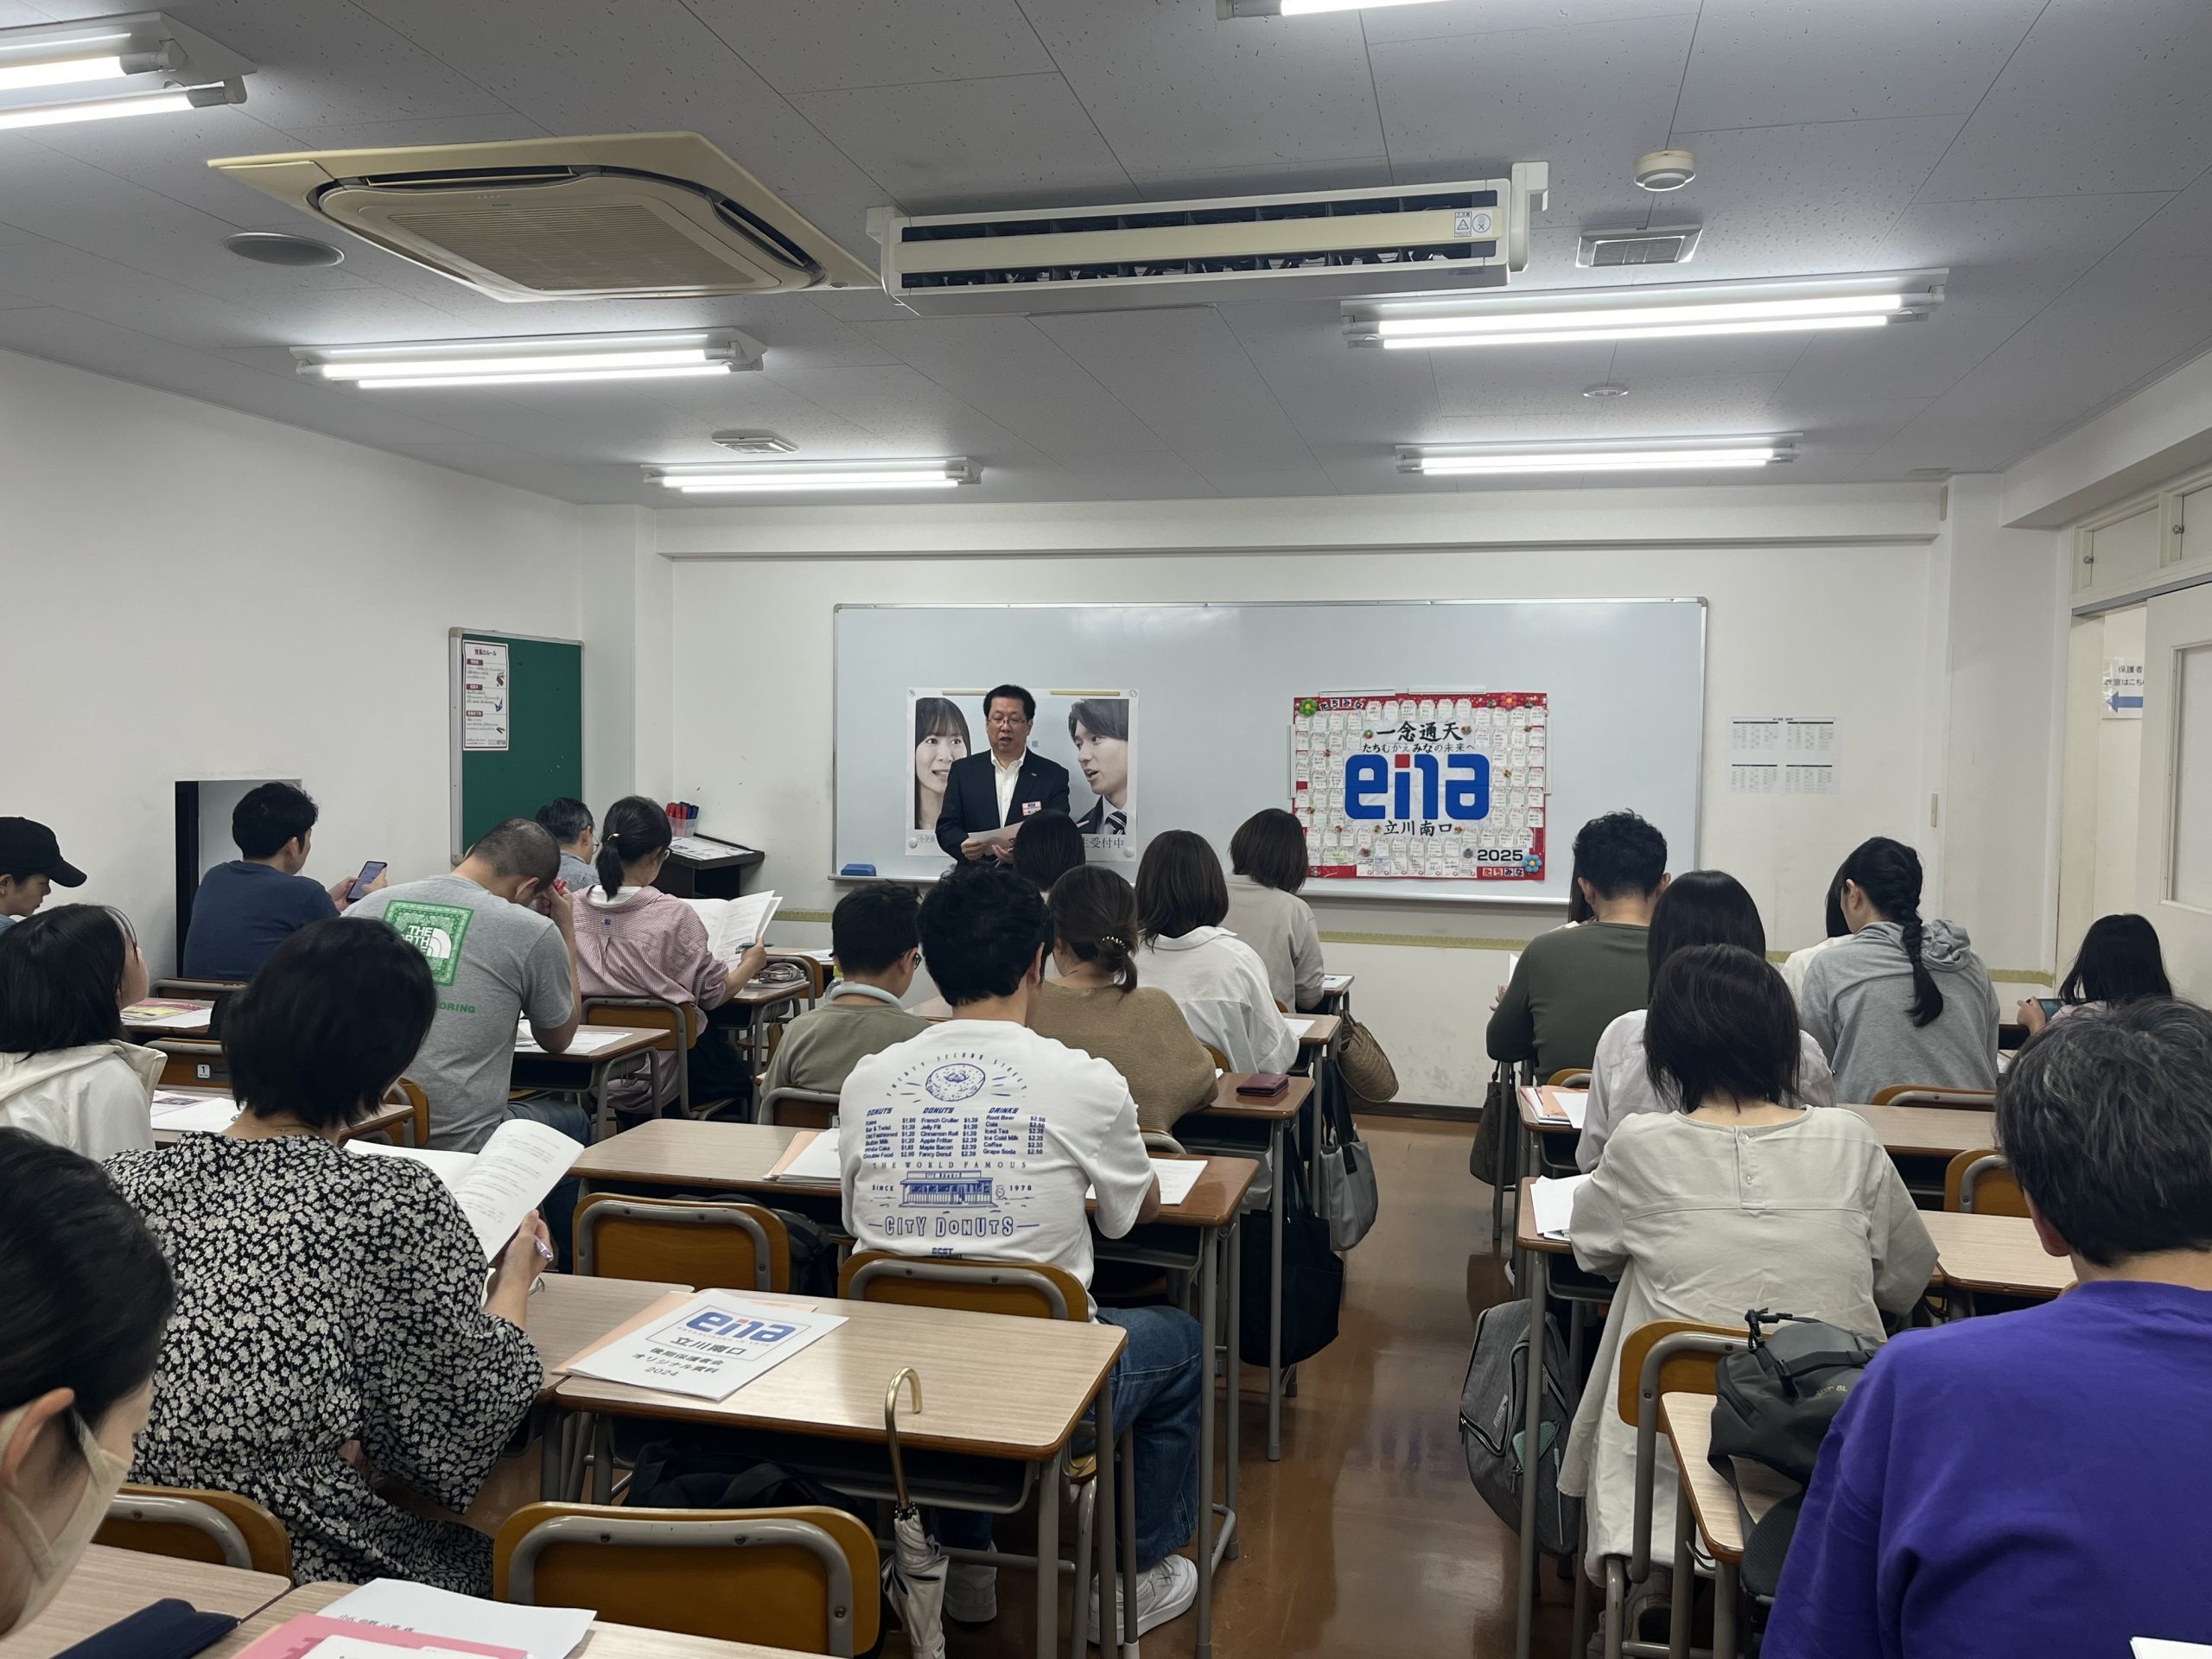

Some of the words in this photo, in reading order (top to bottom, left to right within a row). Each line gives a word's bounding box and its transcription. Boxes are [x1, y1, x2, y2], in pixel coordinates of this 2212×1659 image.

[1319, 698, 1363, 710] たちみな
[1376, 721, 1464, 742] 一念通天
[1362, 743, 1475, 753] たちむかえみなの未来へ
[1344, 753, 1490, 820] ena
[1382, 820, 1452, 836] 立川南口
[1477, 849, 1523, 861] 2025
[1482, 868, 1524, 877] たちみな
[408, 925, 434, 938] THE
[438, 1002, 476, 1014] ORING
[866, 1107, 893, 1116] DONUTS
[885, 1216, 927, 1236] CITY
[936, 1216, 1014, 1237] DONUTS
[686, 1312, 797, 1342] ena
[670, 1337, 747, 1356] 立川南口
[632, 1353, 719, 1374] オリジナル資料
[645, 1366, 679, 1376] 2024
